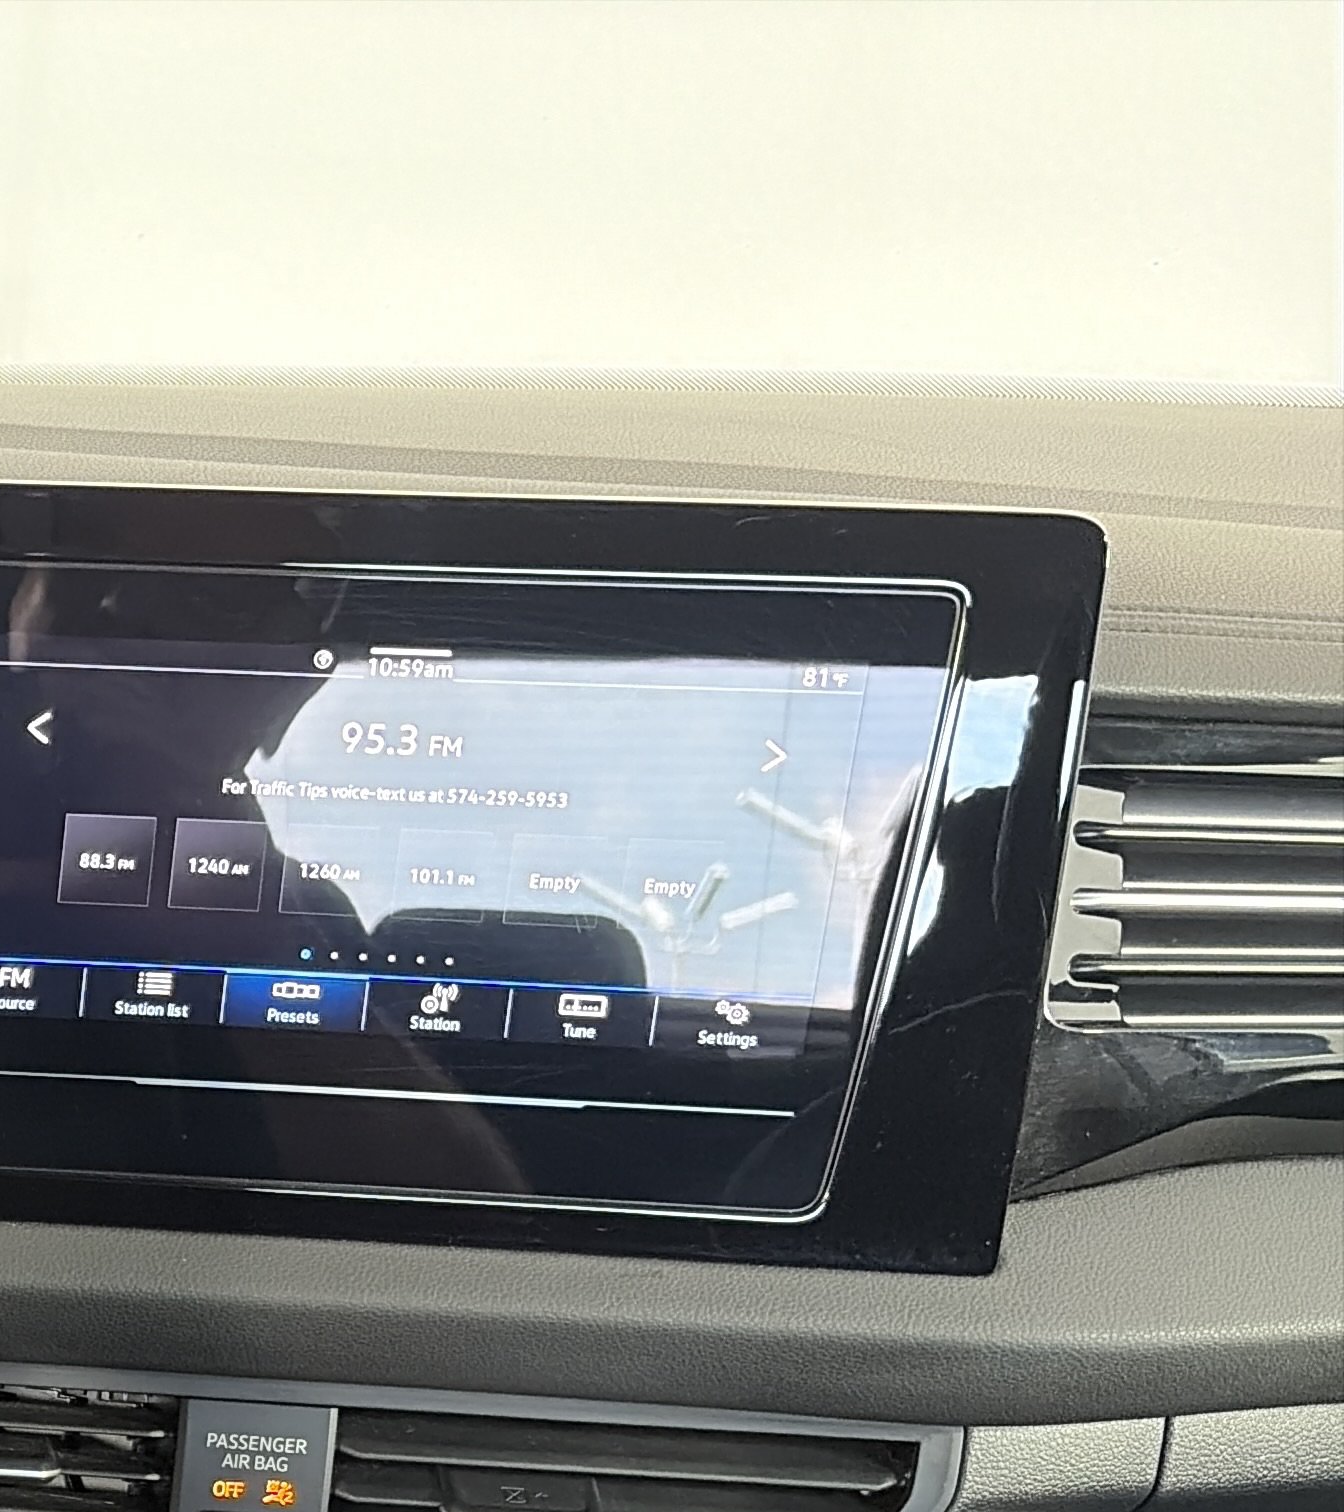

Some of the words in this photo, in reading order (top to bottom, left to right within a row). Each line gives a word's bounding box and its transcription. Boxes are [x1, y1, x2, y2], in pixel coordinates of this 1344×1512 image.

[368, 658, 454, 680] 10:59am
[341, 722, 419, 757] 95.3
[429, 736, 463, 758] FM
[222, 778, 247, 795] For
[250, 779, 294, 798] Traffic
[300, 781, 328, 801] Tips
[330, 783, 407, 804] voice-text
[408, 791, 425, 803] us
[427, 789, 444, 804] at
[447, 788, 569, 809] 574-259-5953
[79, 853, 115, 870] 88.3
[117, 858, 135, 871] FM
[188, 857, 229, 875] 1240
[231, 863, 250, 876] AM
[300, 863, 341, 881] 1260
[343, 868, 361, 881] AM
[410, 868, 456, 886] 101.1
[458, 874, 476, 886] FM
[529, 874, 581, 895] Empty
[643, 878, 696, 899] Empty
[114, 1001, 166, 1018] Station
[169, 1002, 189, 1018] list
[267, 1008, 320, 1025] Presets
[410, 1014, 461, 1034] Station
[562, 1022, 596, 1041] Tune
[697, 1029, 758, 1050] Settings
[206, 1432, 308, 1454] PASSENGER
[221, 1454, 250, 1470] AIR
[254, 1456, 289, 1472] BAG
[212, 1480, 246, 1499] OFF
